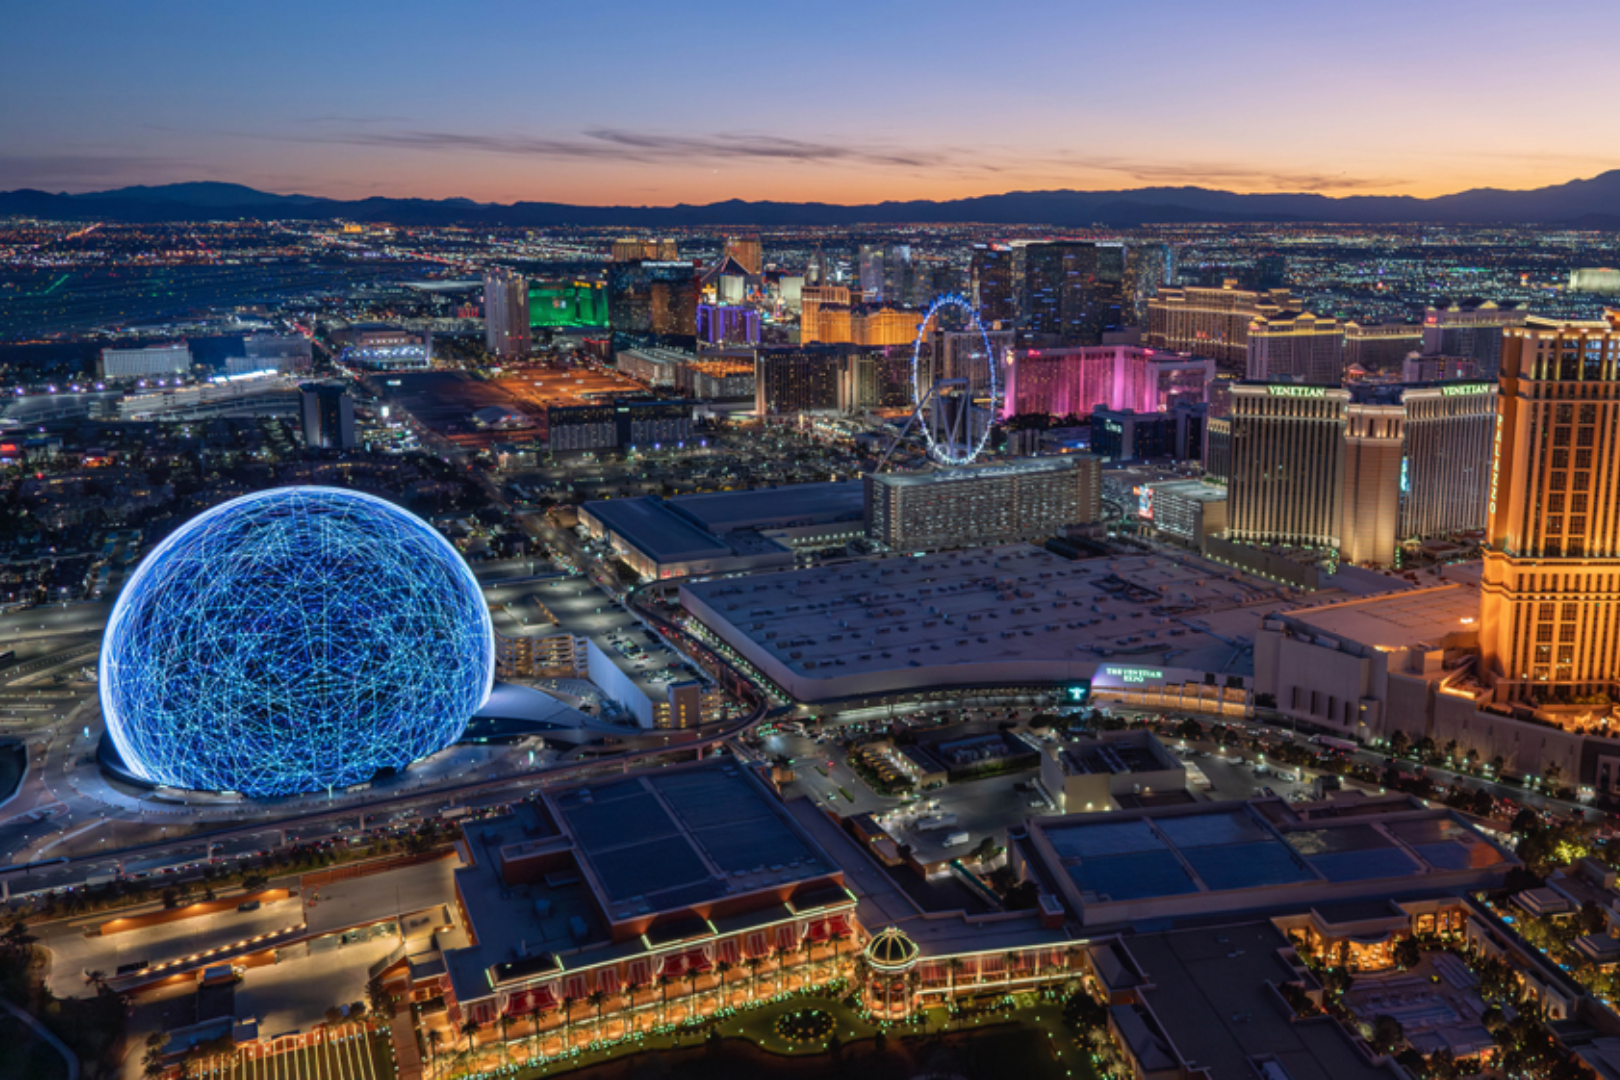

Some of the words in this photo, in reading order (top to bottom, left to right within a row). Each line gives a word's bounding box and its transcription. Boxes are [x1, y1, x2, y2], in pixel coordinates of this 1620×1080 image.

[1268, 385, 1325, 397] VENETIAN
[1442, 383, 1489, 396] VENETIAN
[1489, 413, 1503, 514] PALAZZO
